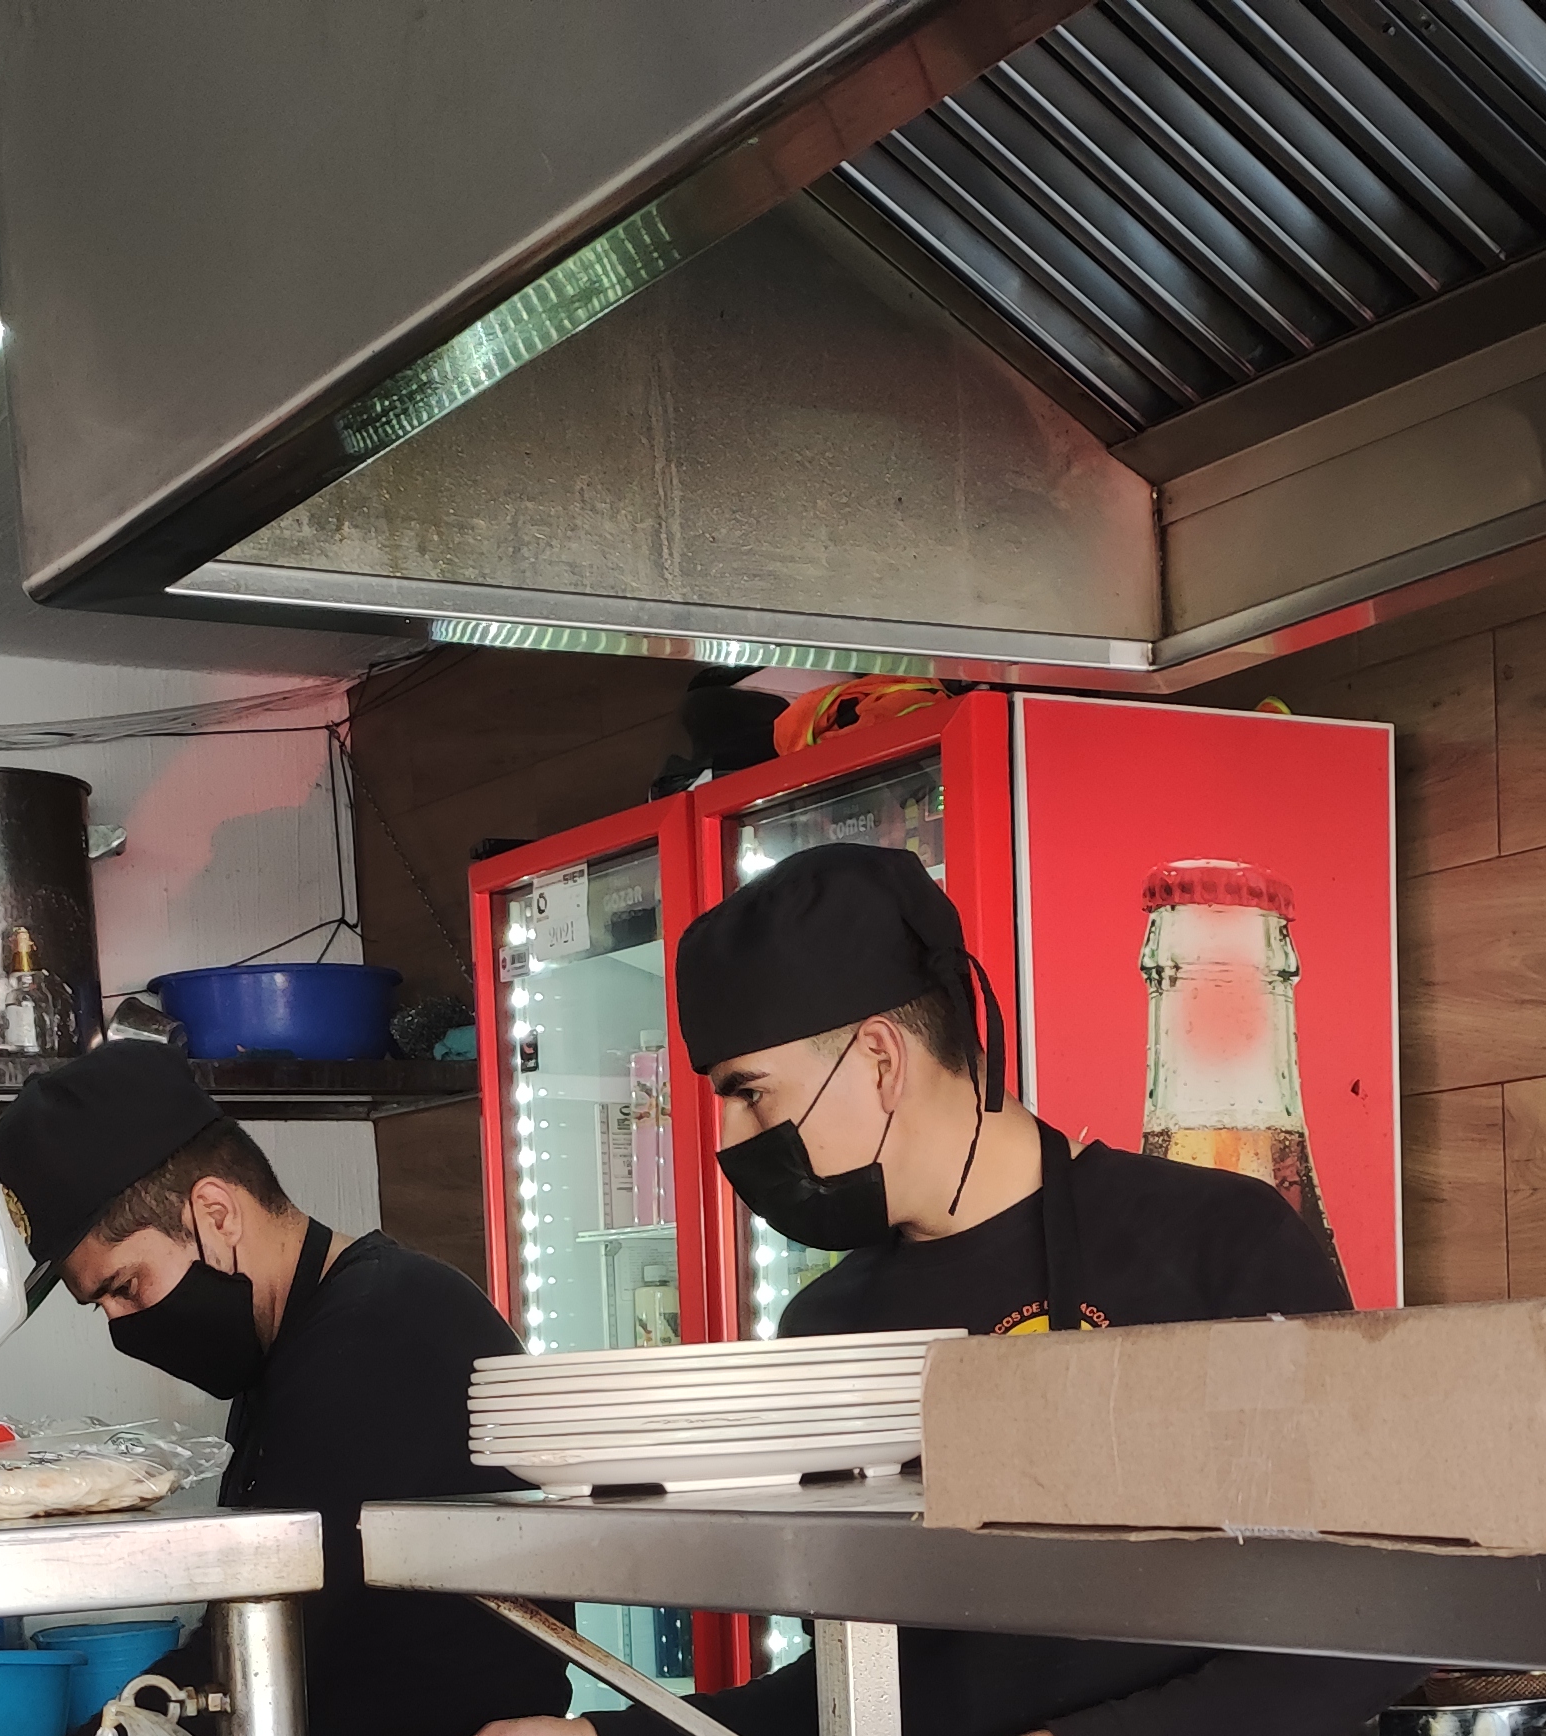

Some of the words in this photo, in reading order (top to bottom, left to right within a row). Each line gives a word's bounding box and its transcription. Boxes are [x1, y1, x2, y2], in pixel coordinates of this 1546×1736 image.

[990, 1311, 1021, 1336] COS
[1022, 1301, 1041, 1317] DE
[1080, 1302, 1110, 1328] ACOA
